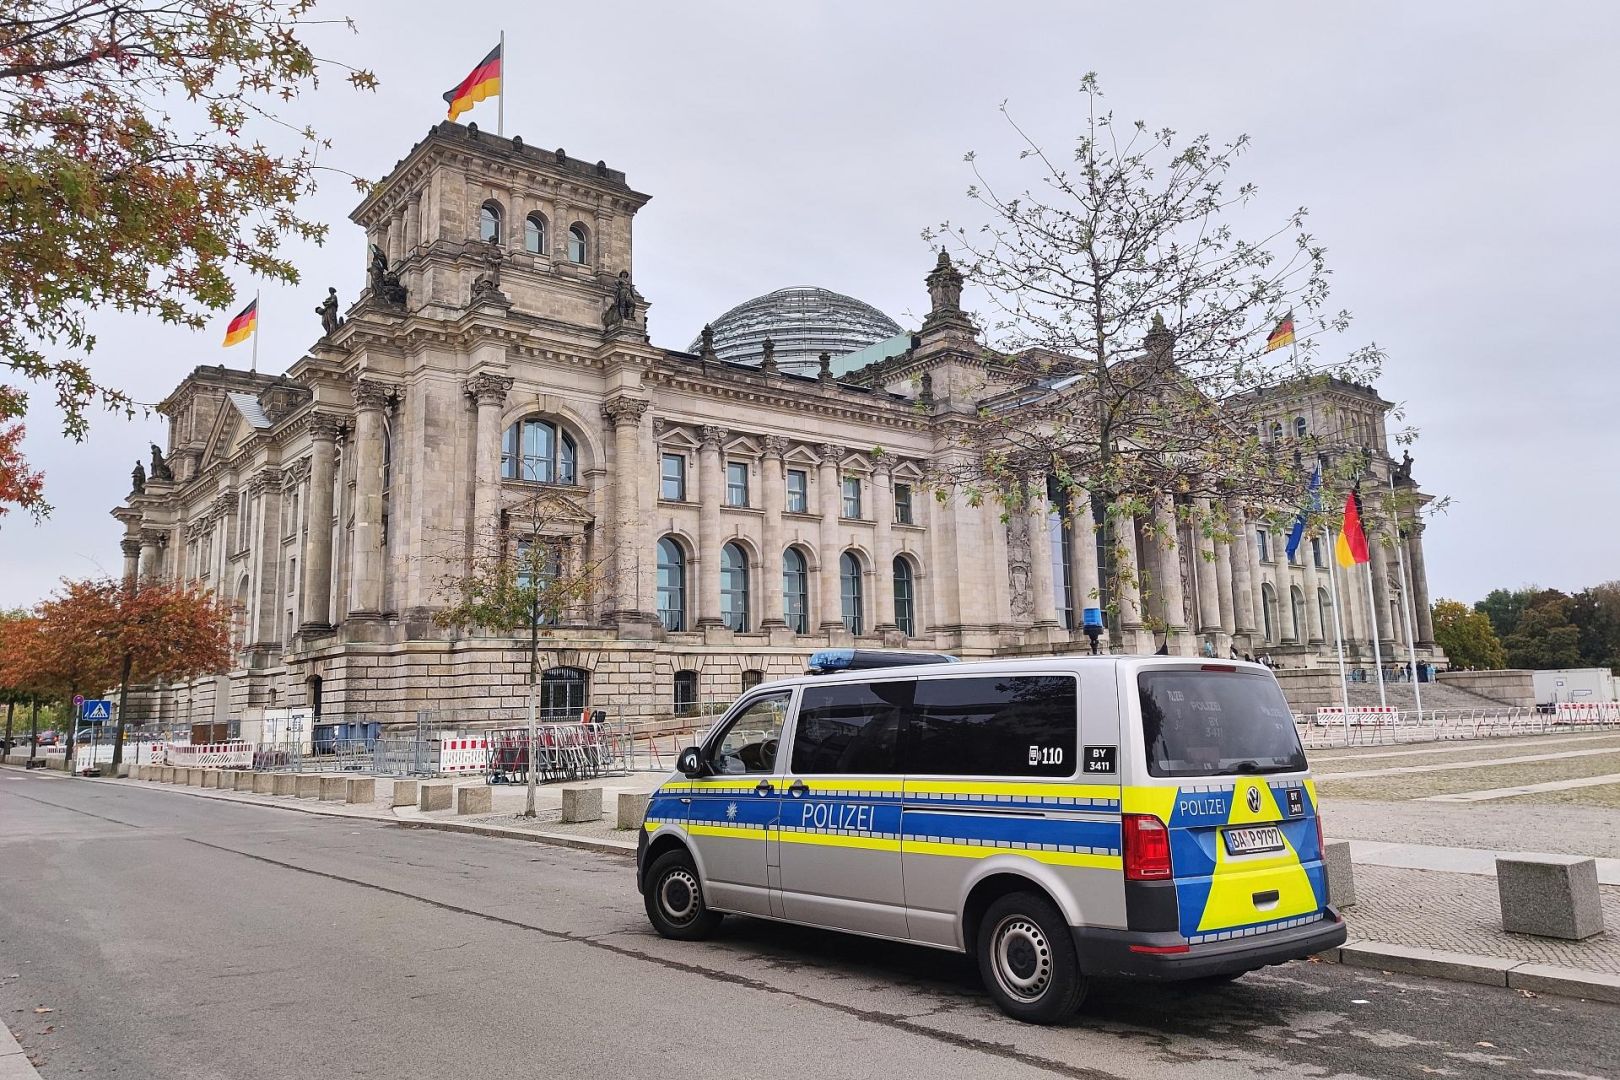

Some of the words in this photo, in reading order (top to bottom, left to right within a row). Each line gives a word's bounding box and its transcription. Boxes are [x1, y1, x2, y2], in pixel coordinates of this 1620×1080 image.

[1042, 747, 1063, 765] 110
[1093, 749, 1107, 758] BY
[1089, 762, 1110, 771] 3411
[1180, 799, 1226, 816] POLIZEI
[1247, 787, 1260, 812] VW
[802, 803, 874, 830] POLIZEI
[1230, 832, 1247, 848] BA
